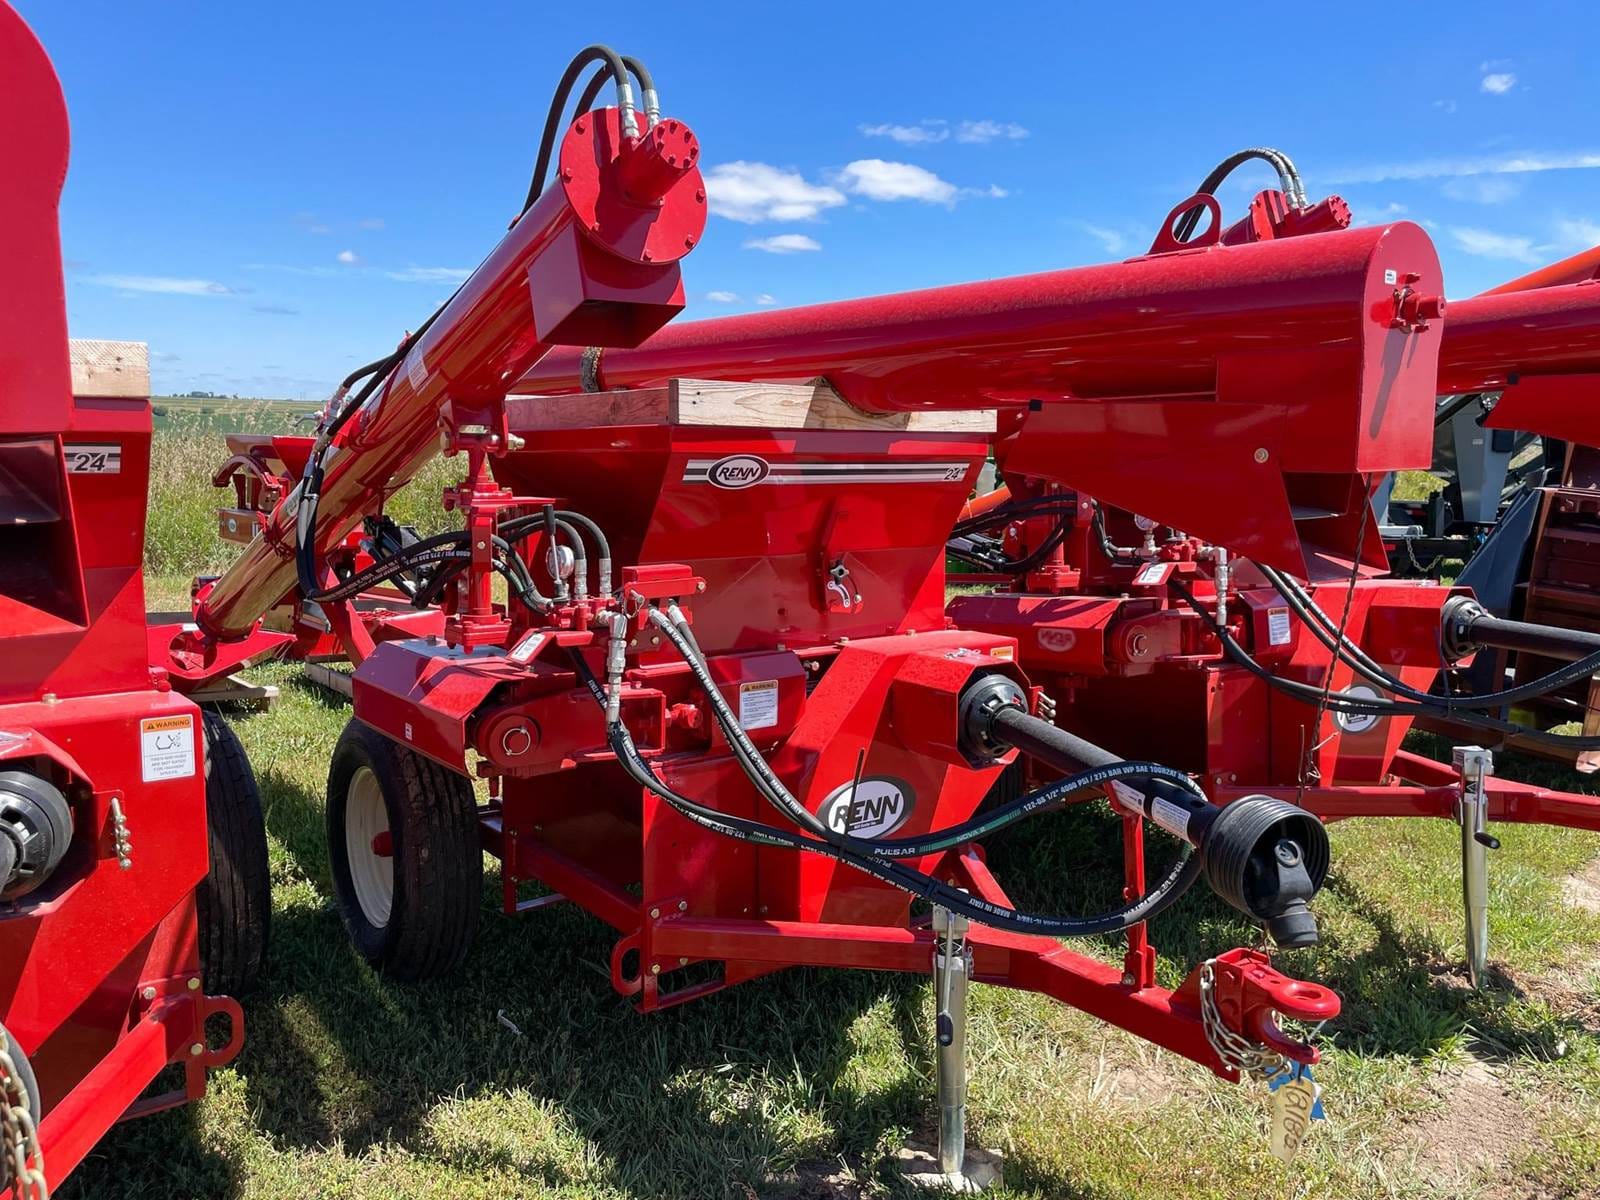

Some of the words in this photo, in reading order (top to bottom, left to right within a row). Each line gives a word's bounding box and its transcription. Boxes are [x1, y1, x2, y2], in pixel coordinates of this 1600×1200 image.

[73, 453, 107, 472] 24
[718, 466, 760, 481] RENN
[156, 719, 190, 728] WARNING
[1046, 789, 1059, 800] 1/2"
[1060, 781, 1078, 794] 4000
[1078, 776, 1089, 787] PSI
[1094, 770, 1107, 781] 275
[1107, 767, 1122, 777] BAR
[1122, 766, 1134, 774] WP
[1135, 765, 1148, 773] SAE
[1149, 766, 1177, 777] 100R2AT
[833, 793, 900, 829] RENN
[874, 847, 916, 856] PULSAR
[968, 898, 985, 910] ITALY
[993, 907, 1011, 919] MADE
